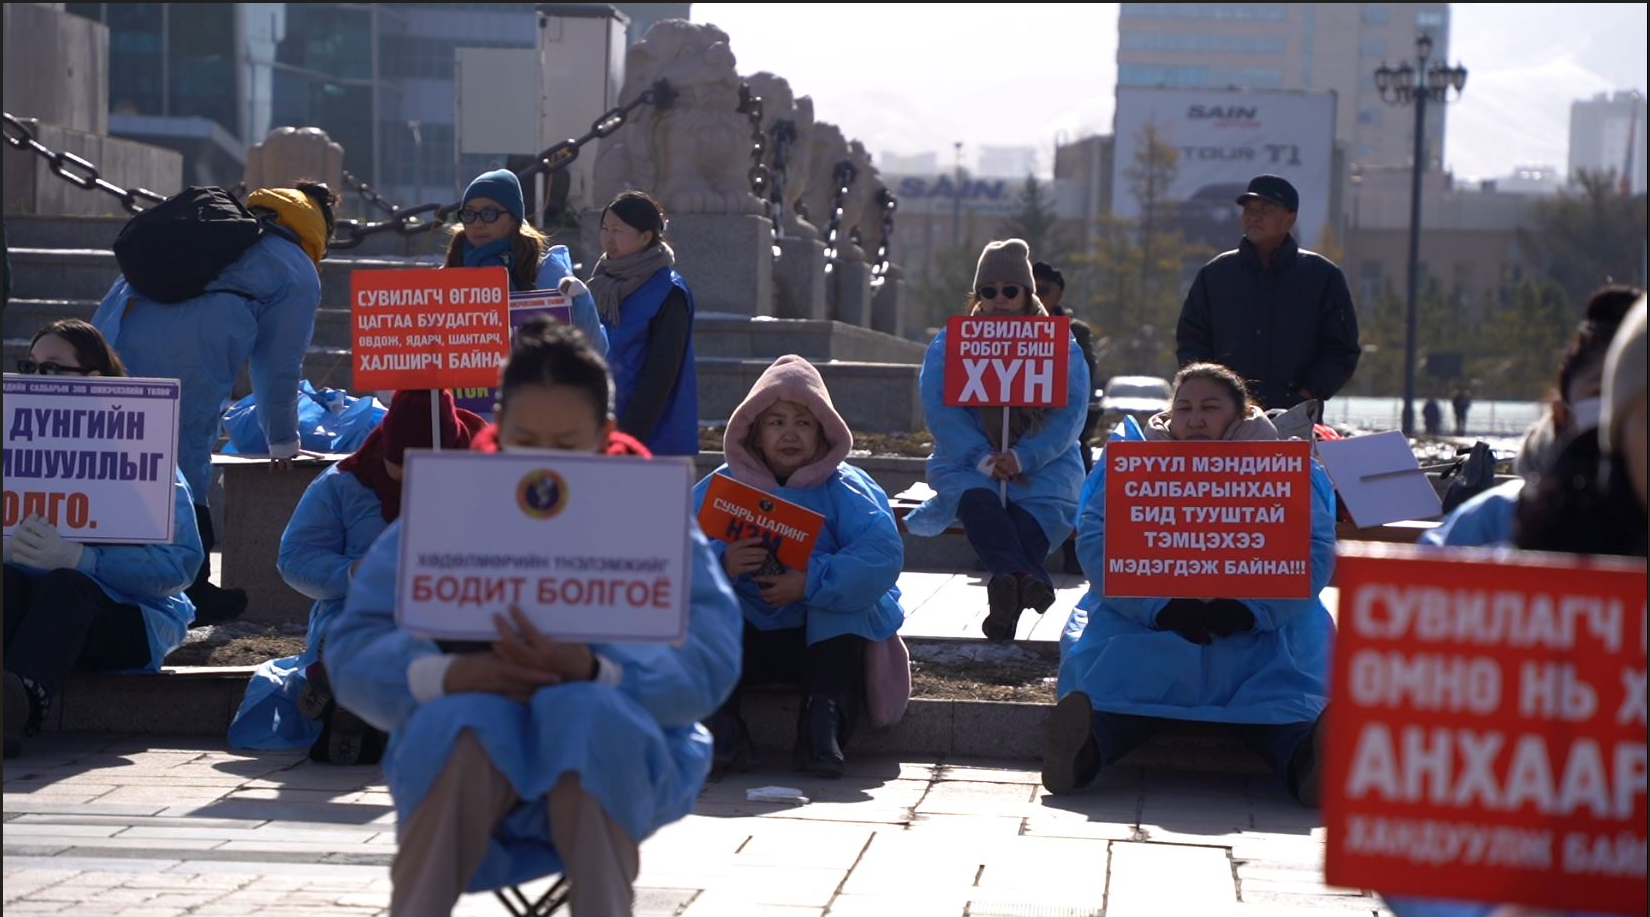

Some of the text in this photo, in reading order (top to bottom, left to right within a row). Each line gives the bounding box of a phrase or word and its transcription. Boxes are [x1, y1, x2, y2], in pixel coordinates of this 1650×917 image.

[1187, 104, 1258, 119] SAIN
[899, 174, 1006, 199] SAIN
[358, 288, 443, 307] СУВИЛАГЧ
[449, 286, 502, 305] ӨГЛӨӨ
[358, 309, 502, 330] ЦАГТАА БУУДАГГҮЙ,
[961, 321, 1056, 339] СУВИЛАГЧ
[406, 334, 445, 348] ЯДАРЧ,
[449, 332, 503, 346] ШАНТАРЧ,
[960, 341, 1055, 357] РОБОТ БИШ
[360, 350, 501, 371] ХАЛШИРЧ БАЙНА
[958, 358, 1054, 403] ХҮН
[9, 405, 145, 441] ДҮНГИЙН
[1114, 453, 1302, 475] ЭРҮҮЛ МЭНДИЙН
[1124, 481, 1291, 498] САЛБАРЫНХАН
[713, 497, 810, 543] СУУРЬ ЦАЛИНГ
[1130, 504, 1285, 525] БИД ТУУШТАЙ
[1144, 532, 1266, 551] ТЭМЦЭХЭЭ
[1109, 558, 1306, 576] МЭДЭГДЭЖ БАЙНА!!!
[412, 574, 672, 608] БОДИТ БОЛГОЁ
[1355, 583, 1623, 654] СУВИЛАГЧ
[1519, 661, 1598, 723] НЬ
[1346, 720, 1647, 821] АНХААР
